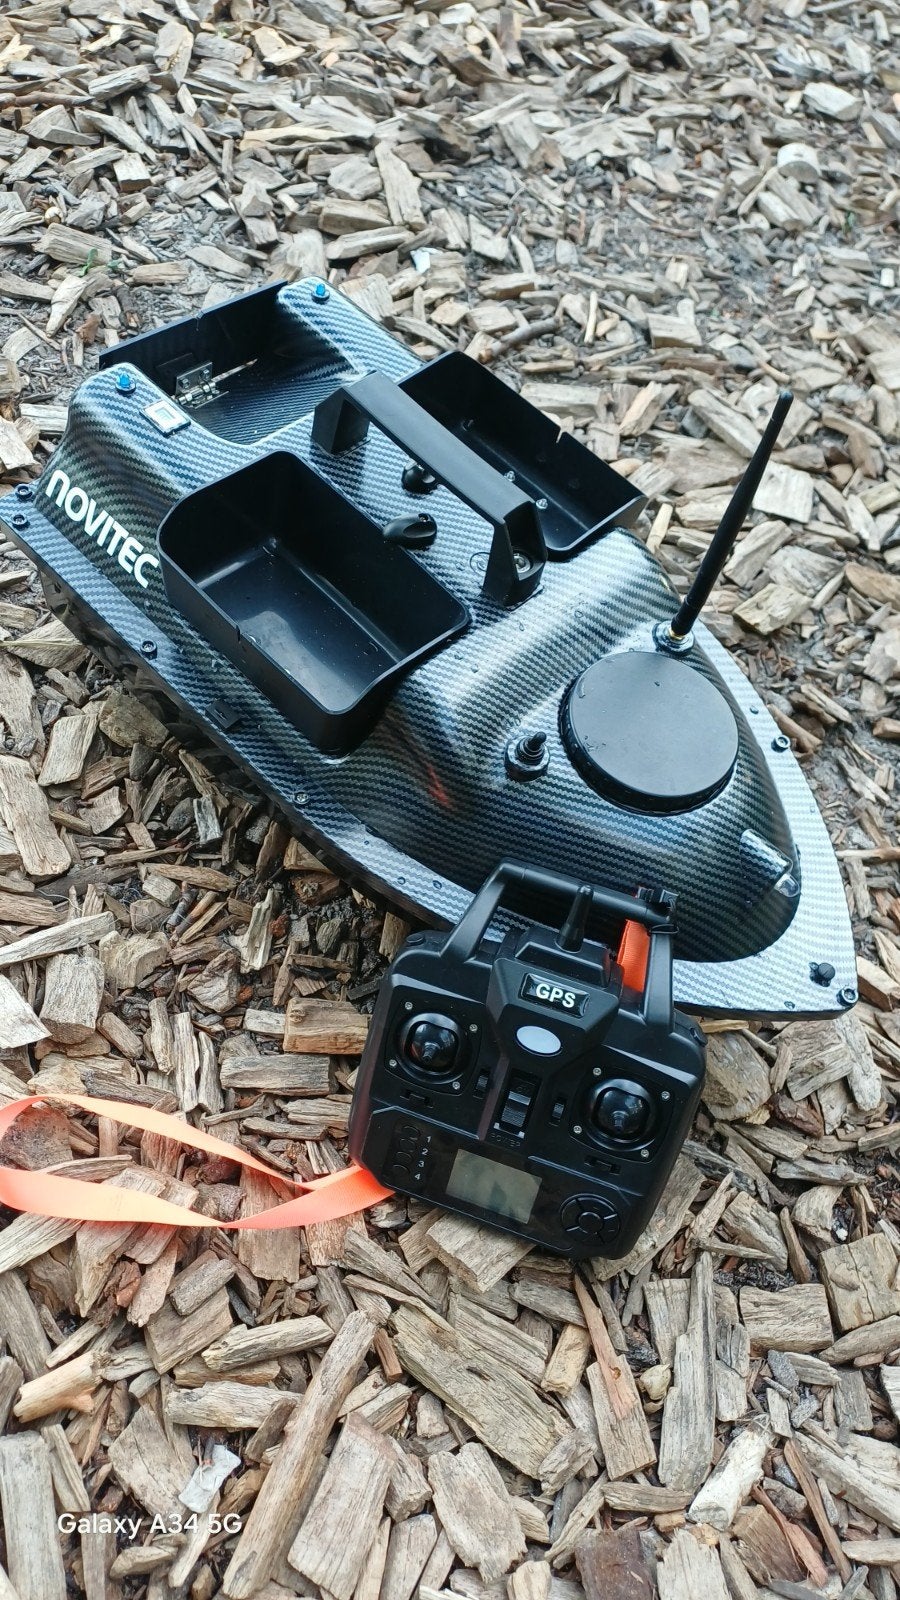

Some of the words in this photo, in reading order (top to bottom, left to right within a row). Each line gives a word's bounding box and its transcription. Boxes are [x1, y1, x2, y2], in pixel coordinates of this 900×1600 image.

[45, 469, 160, 589] NOVITEC
[535, 983, 576, 1008] GPS
[426, 1135, 432, 1143] 1
[421, 1148, 429, 1156] 2
[418, 1160, 425, 1168] 3
